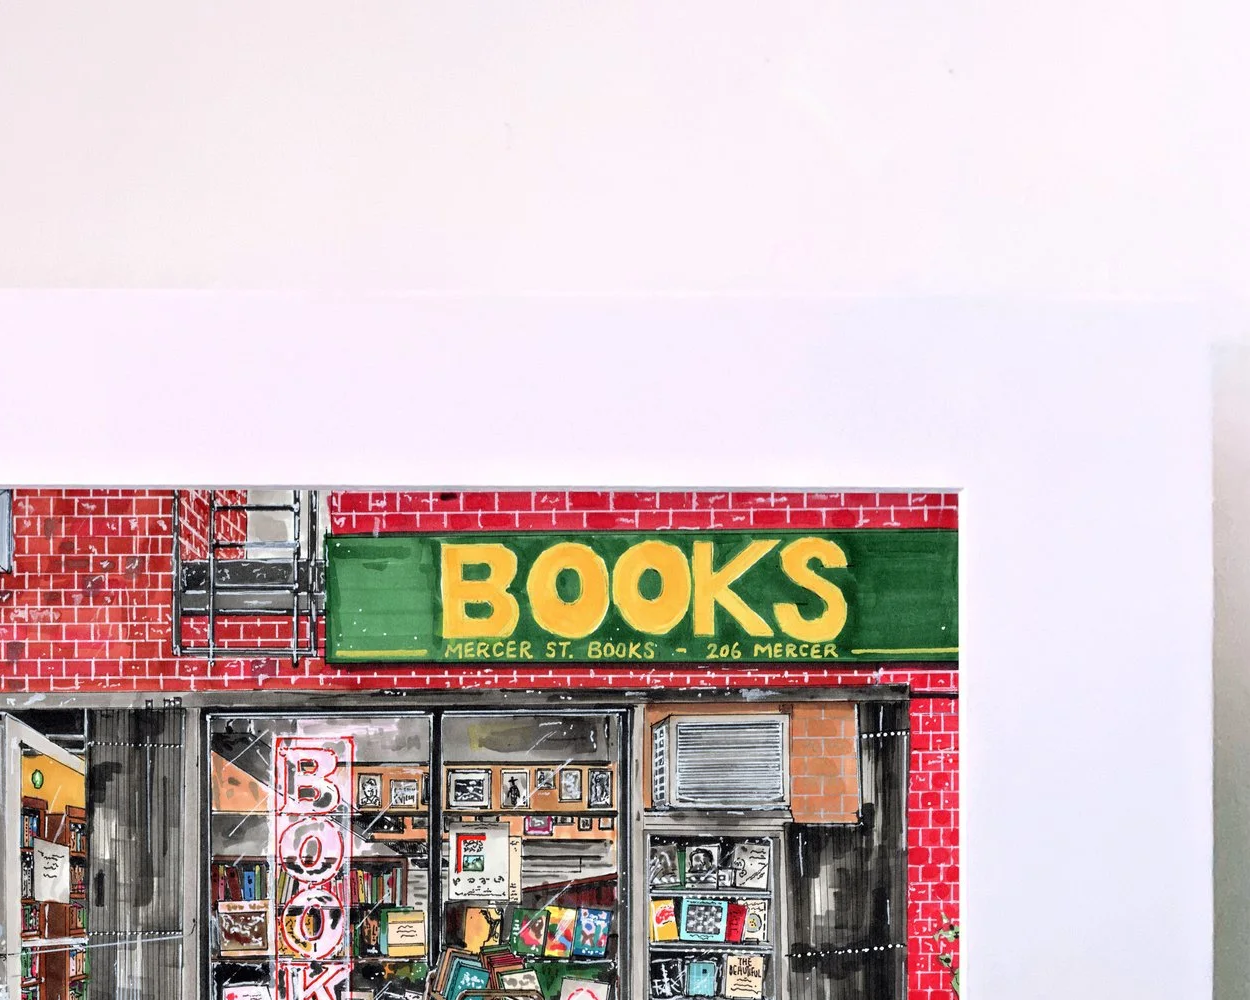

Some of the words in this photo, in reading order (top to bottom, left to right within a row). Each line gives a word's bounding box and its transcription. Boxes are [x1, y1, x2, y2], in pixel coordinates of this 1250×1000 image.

[440, 537, 848, 642] BOOKS
[444, 640, 534, 660] MERCER
[545, 640, 575, 660] ST.
[586, 640, 656, 660] BOOKS
[705, 641, 743, 660] 206
[752, 641, 840, 660] MERCER
[737, 957, 752, 967] THE
